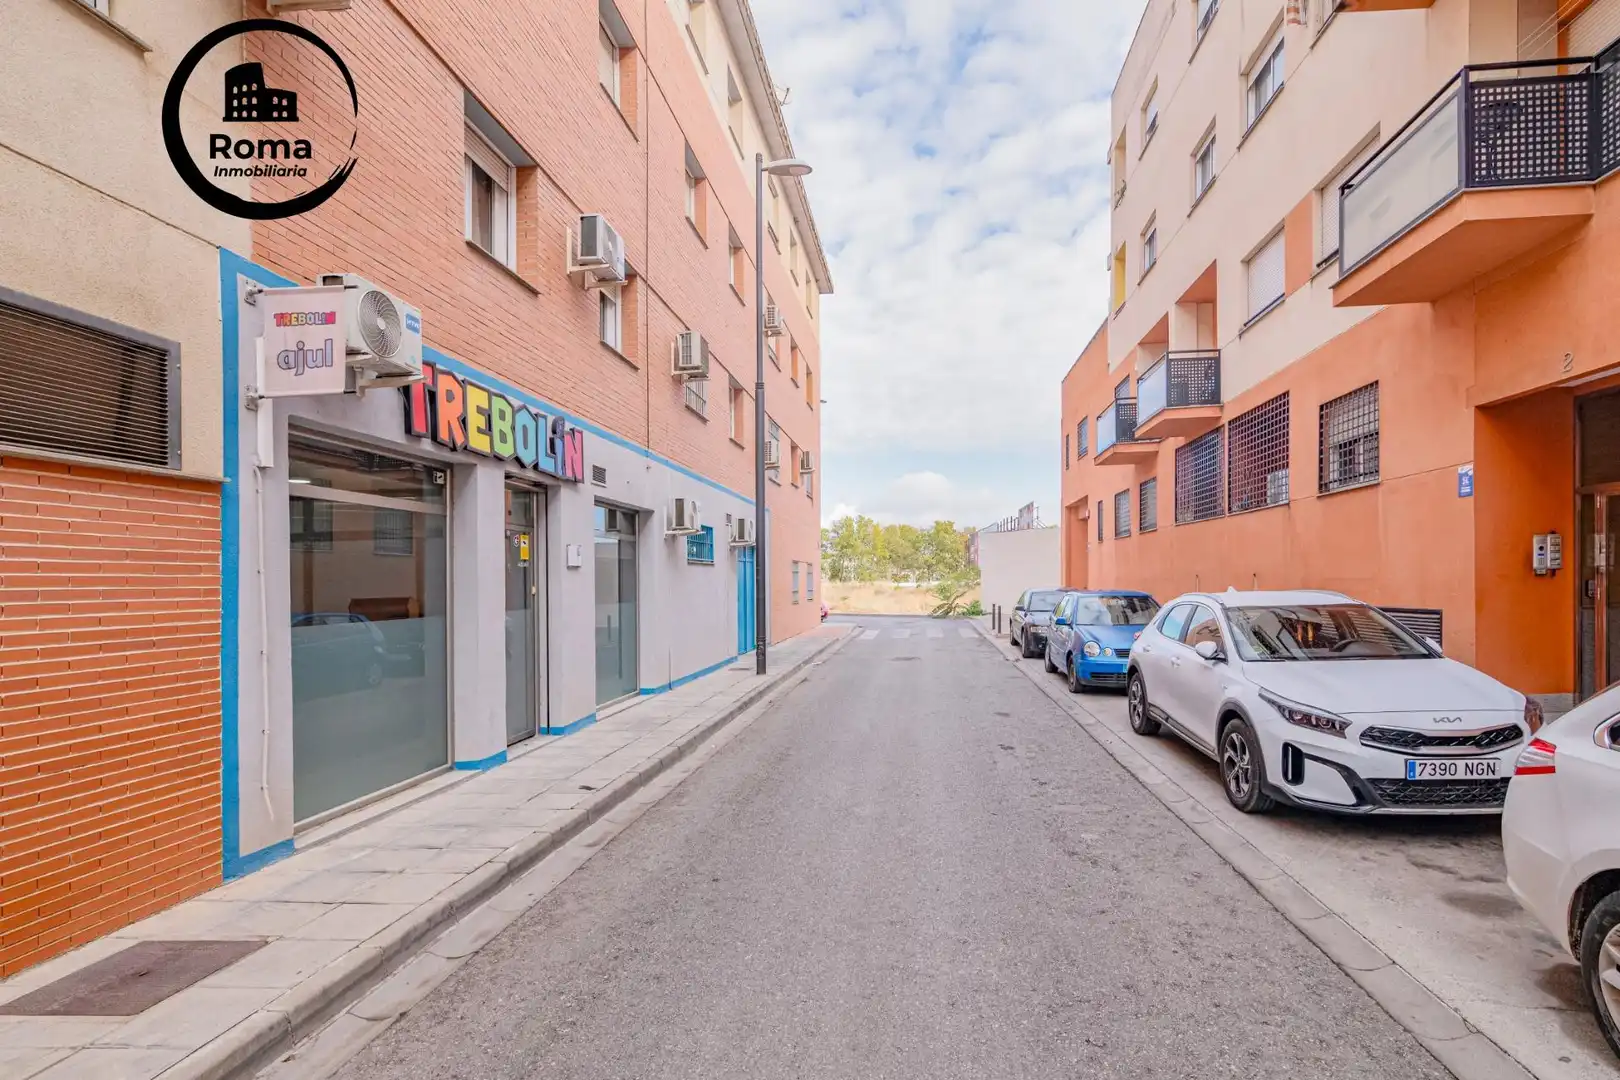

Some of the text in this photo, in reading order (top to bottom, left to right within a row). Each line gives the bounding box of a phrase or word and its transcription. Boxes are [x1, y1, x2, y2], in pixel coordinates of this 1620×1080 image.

[277, 338, 334, 376] ajul
[1563, 352, 1574, 373] 2
[1418, 762, 1496, 777] 7390 NGN
